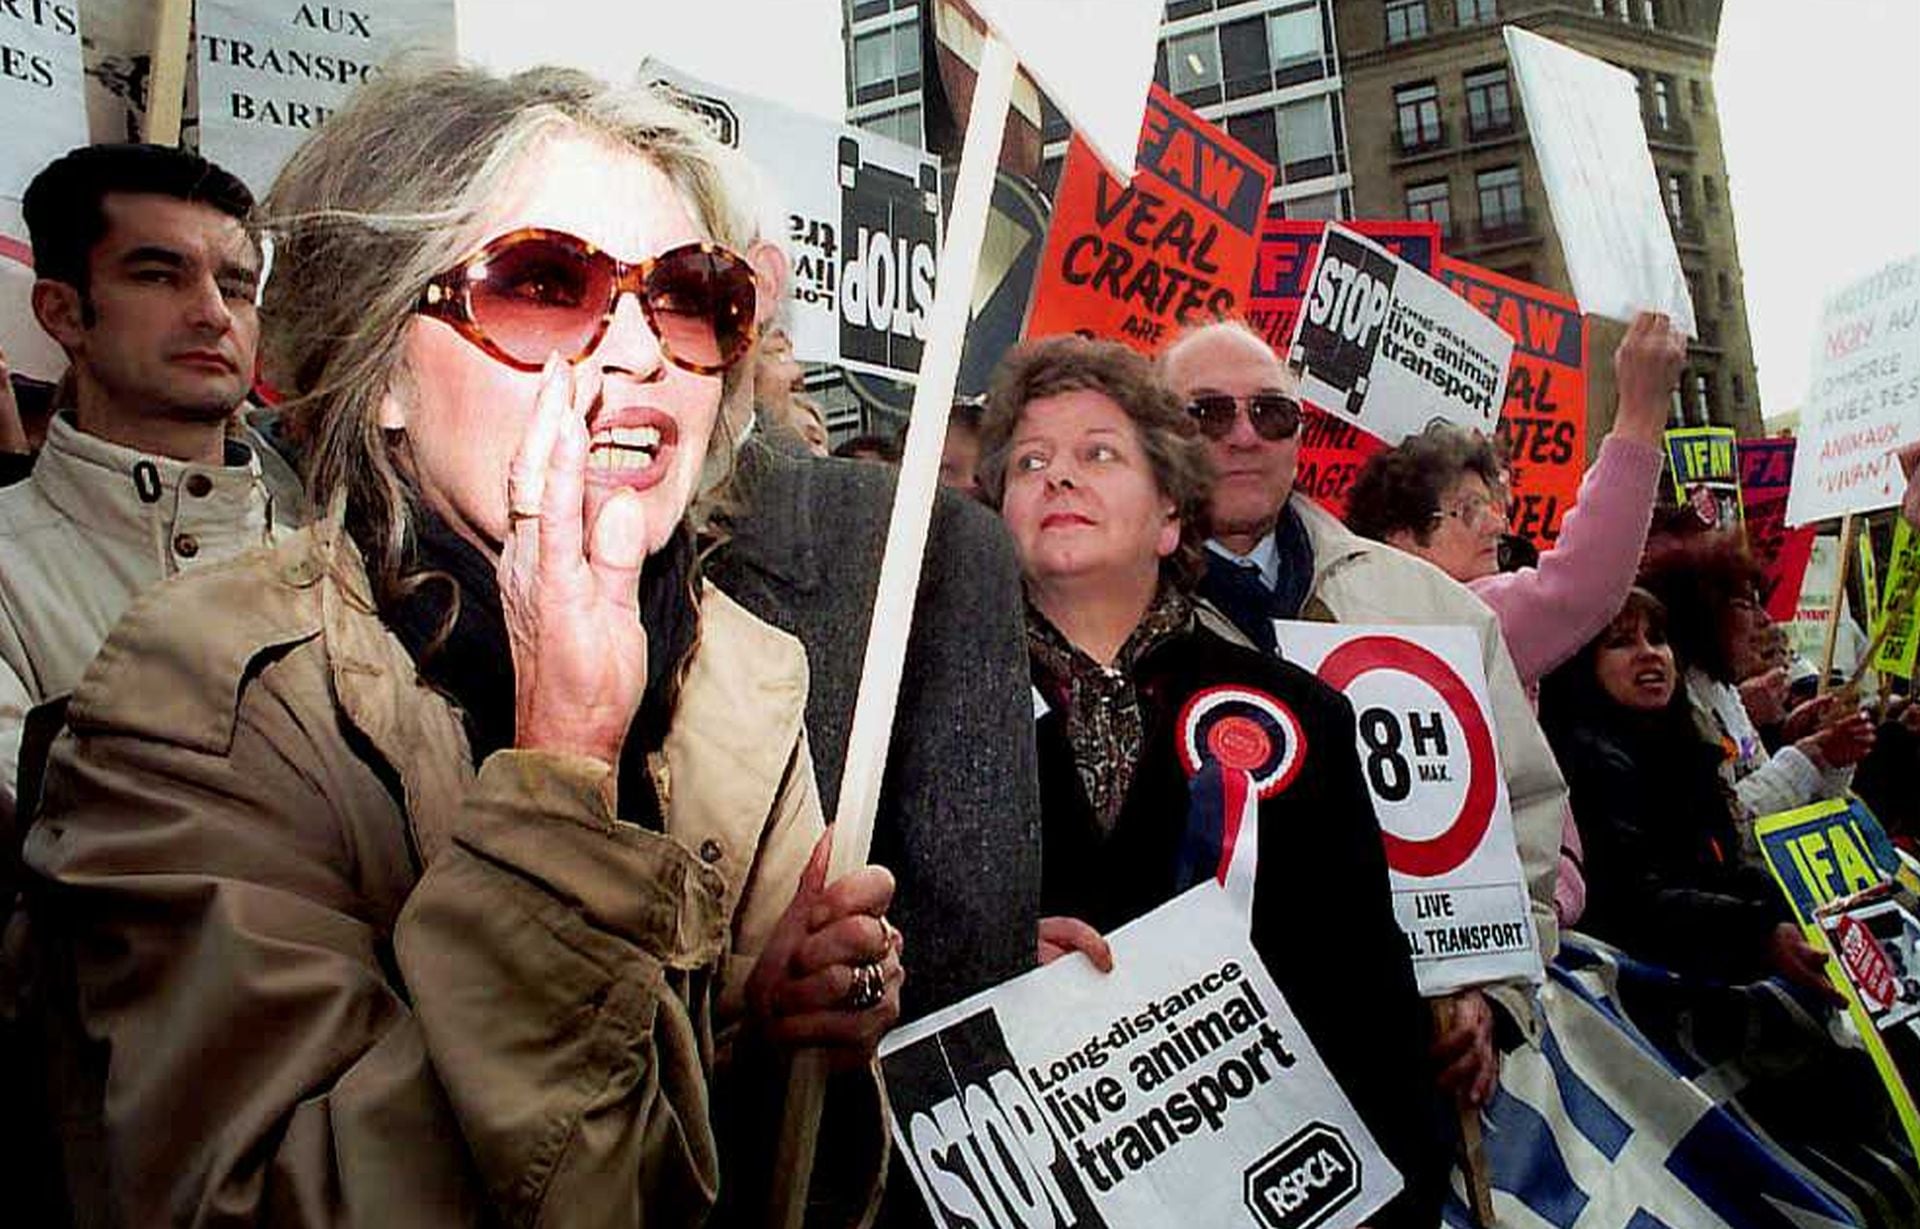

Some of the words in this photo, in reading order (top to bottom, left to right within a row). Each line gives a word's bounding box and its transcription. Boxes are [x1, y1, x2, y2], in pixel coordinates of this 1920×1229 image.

[292, 4, 371, 37] AUX
[1095, 172, 1219, 274] VEAL
[840, 226, 936, 339] STOP
[1310, 257, 1389, 348] STOP
[1120, 314, 1163, 345] ARE
[1388, 310, 1426, 349] live
[1433, 342, 1498, 397] animal
[1383, 332, 1492, 419] transport
[1417, 762, 1453, 784] MAX.
[1415, 893, 1454, 919] LIVE
[1425, 922, 1524, 954] TRANSPORT
[1028, 959, 1242, 1093] Long-distance
[1046, 1073, 1127, 1141] live
[1129, 979, 1270, 1094] animal
[909, 1069, 1078, 1229] STOP
[1075, 1025, 1298, 1194] transport
[1264, 1148, 1347, 1219] RSPCA
